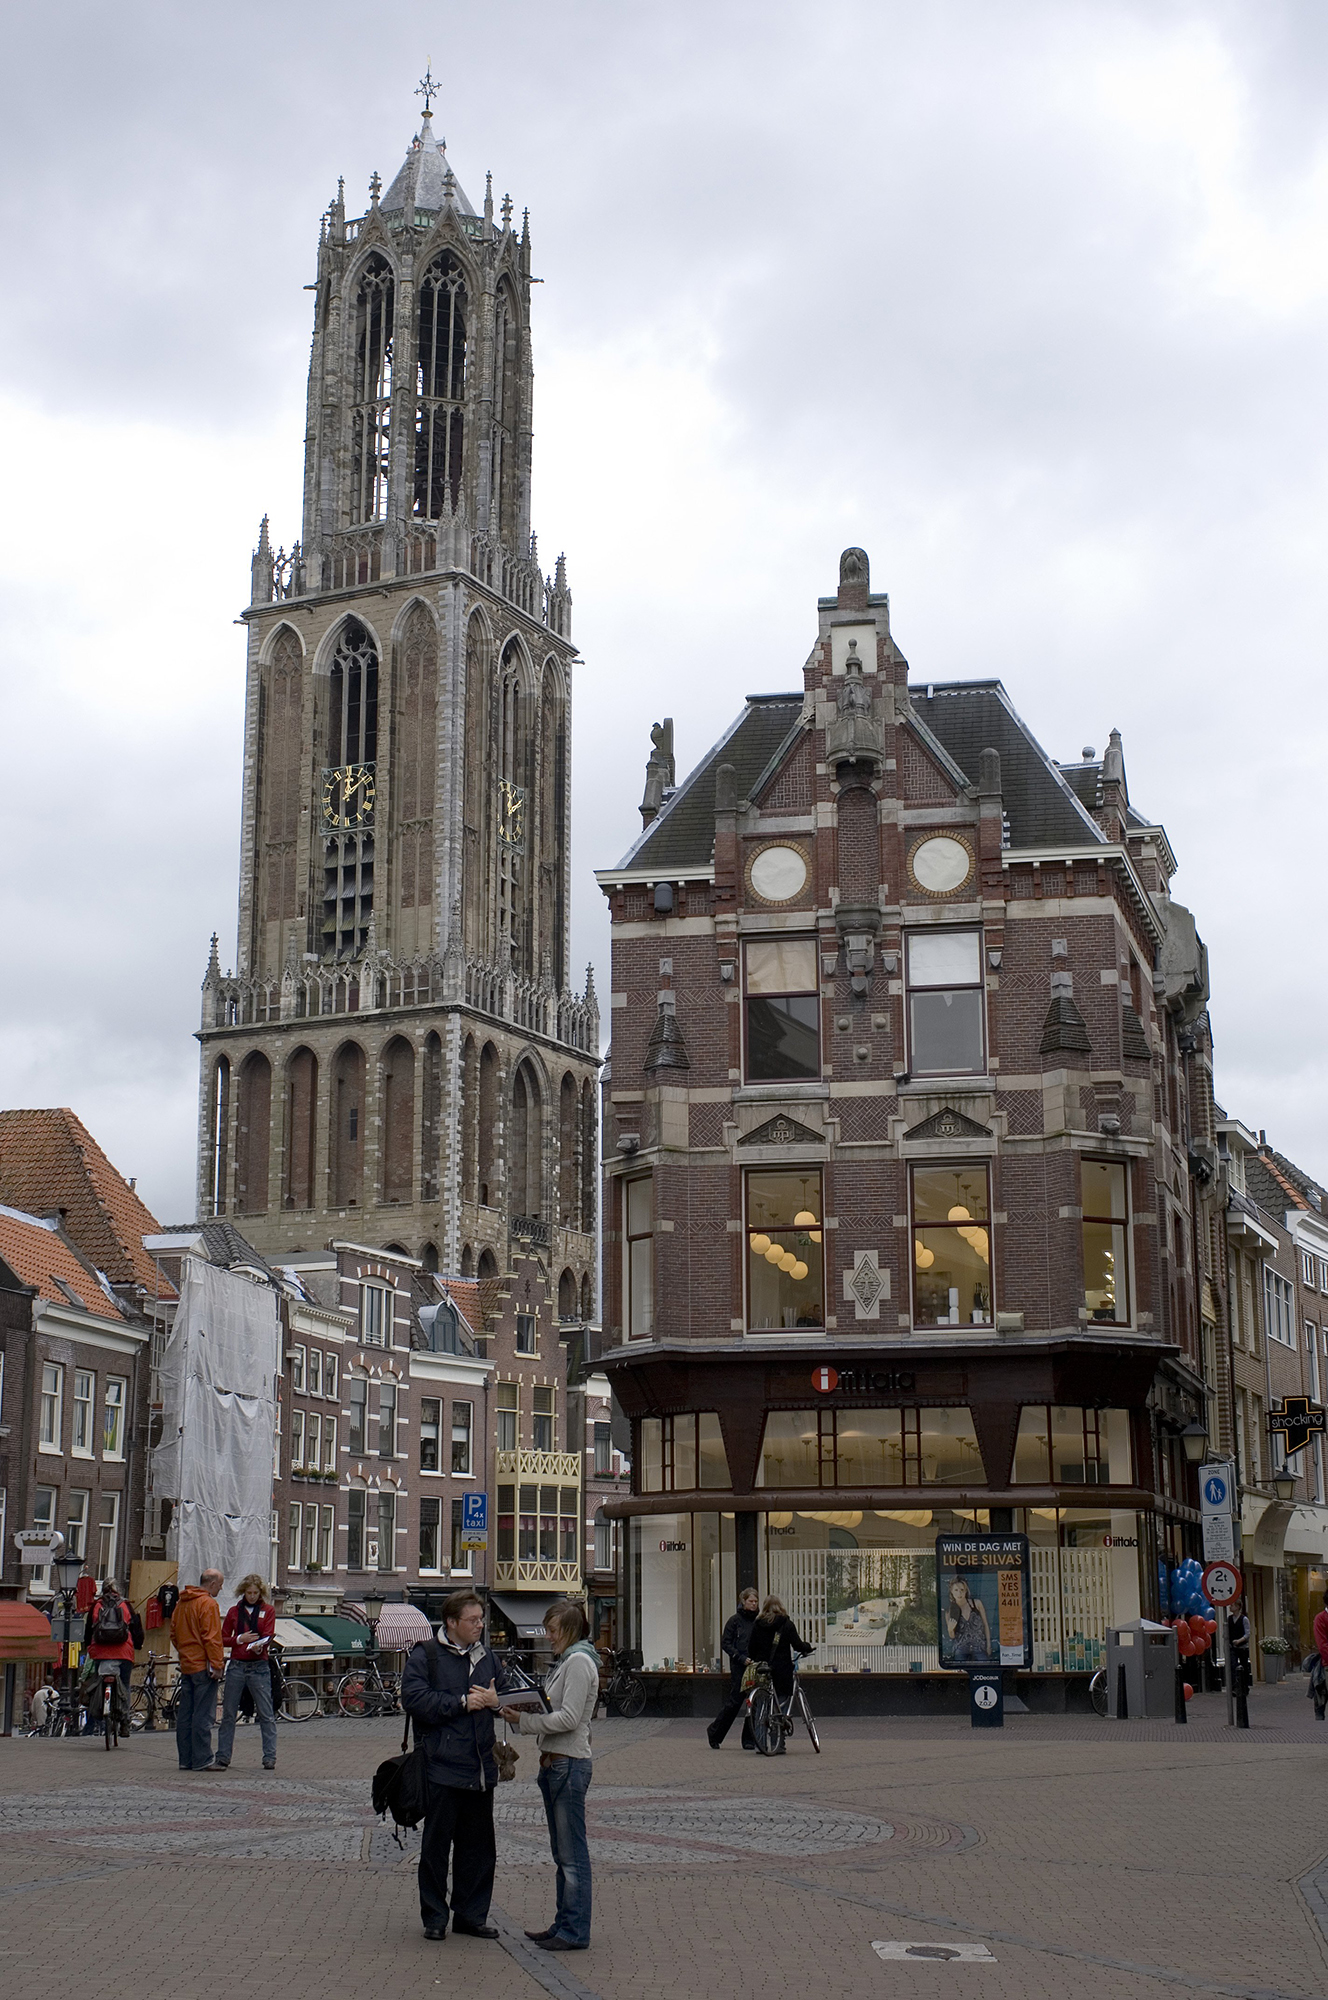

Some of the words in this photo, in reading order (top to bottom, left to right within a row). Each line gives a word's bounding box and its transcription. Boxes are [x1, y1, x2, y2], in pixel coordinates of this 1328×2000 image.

[840, 1367, 916, 1392] iittala
[1271, 1412, 1323, 1428] shocking
[468, 1495, 482, 1515] P
[466, 1518, 484, 1527] taxi
[942, 1543, 962, 1552] WIN
[964, 1542, 977, 1551] DE
[979, 1542, 1000, 1551] DAG
[1002, 1542, 1022, 1551] MET
[1112, 1536, 1139, 1547] iittala
[943, 1554, 978, 1566] LUCIE
[981, 1554, 1022, 1566] SILVAS
[1001, 1582, 1019, 1591] YES
